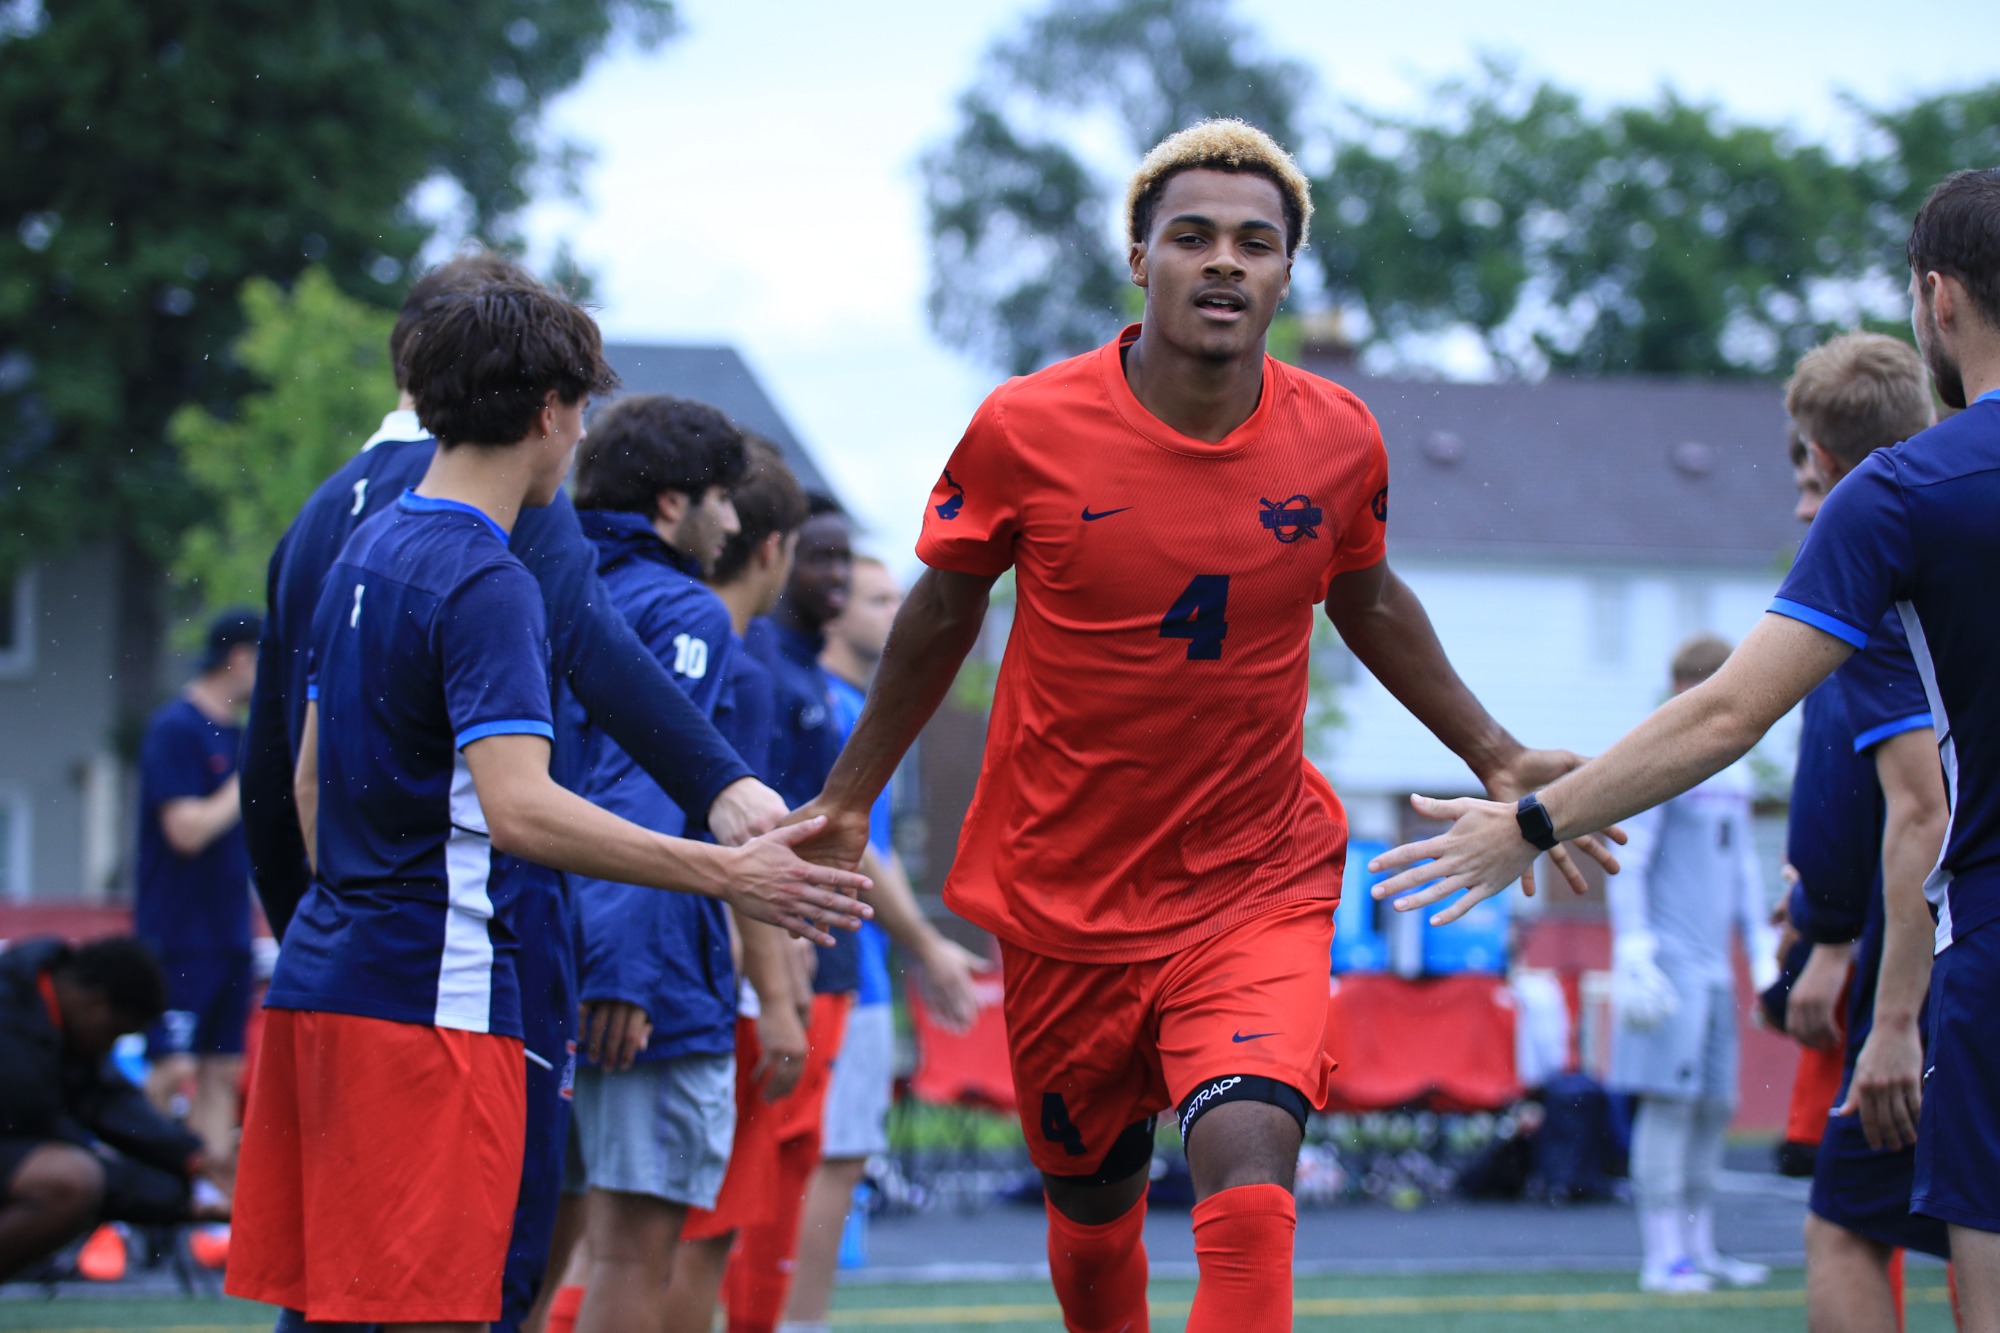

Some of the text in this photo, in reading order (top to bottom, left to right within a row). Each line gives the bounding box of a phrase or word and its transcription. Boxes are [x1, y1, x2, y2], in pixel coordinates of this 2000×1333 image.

[1159, 574, 1230, 660] 4
[673, 633, 708, 679] 10
[1041, 1092, 1088, 1156] 4
